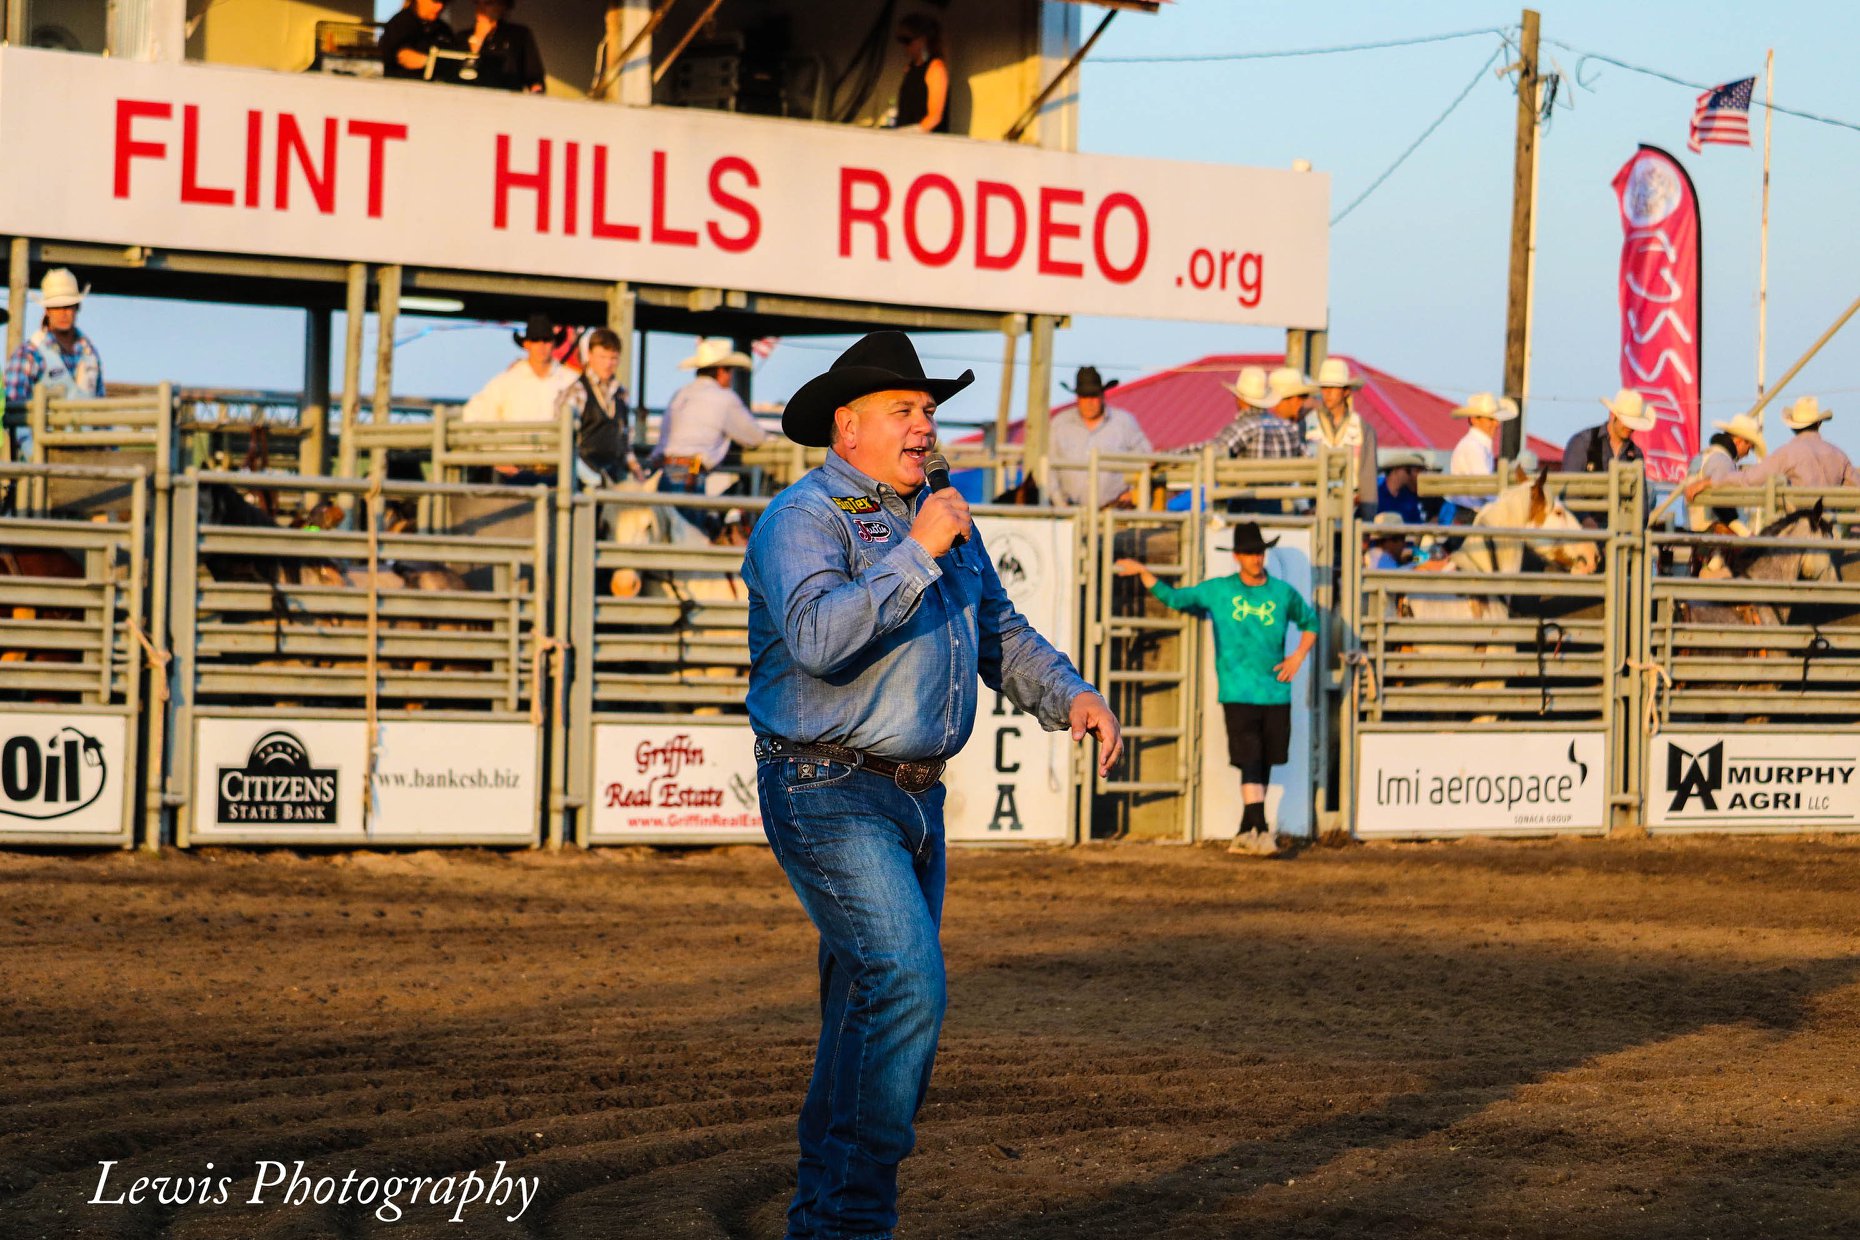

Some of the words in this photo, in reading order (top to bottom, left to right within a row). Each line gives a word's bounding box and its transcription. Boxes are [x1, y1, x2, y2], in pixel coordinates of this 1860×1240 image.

[114, 99, 408, 218] FLINT
[493, 134, 761, 253] HILLS
[839, 166, 1149, 284] RODEO
[1176, 247, 1263, 309] .org
[2, 735, 81, 803] Oil
[635, 735, 705, 779] Griffin
[221, 770, 336, 804] CITIZENS
[1377, 768, 1420, 806] lmi
[1430, 774, 1573, 812] aerospace
[1728, 766, 1855, 784] MURPHY
[606, 779, 655, 808] Real
[659, 783, 725, 809] Estate
[1728, 792, 1801, 810] AGRI
[1807, 796, 1830, 810] LLC
[228, 804, 279, 820] STATE
[282, 804, 326, 821] BANK
